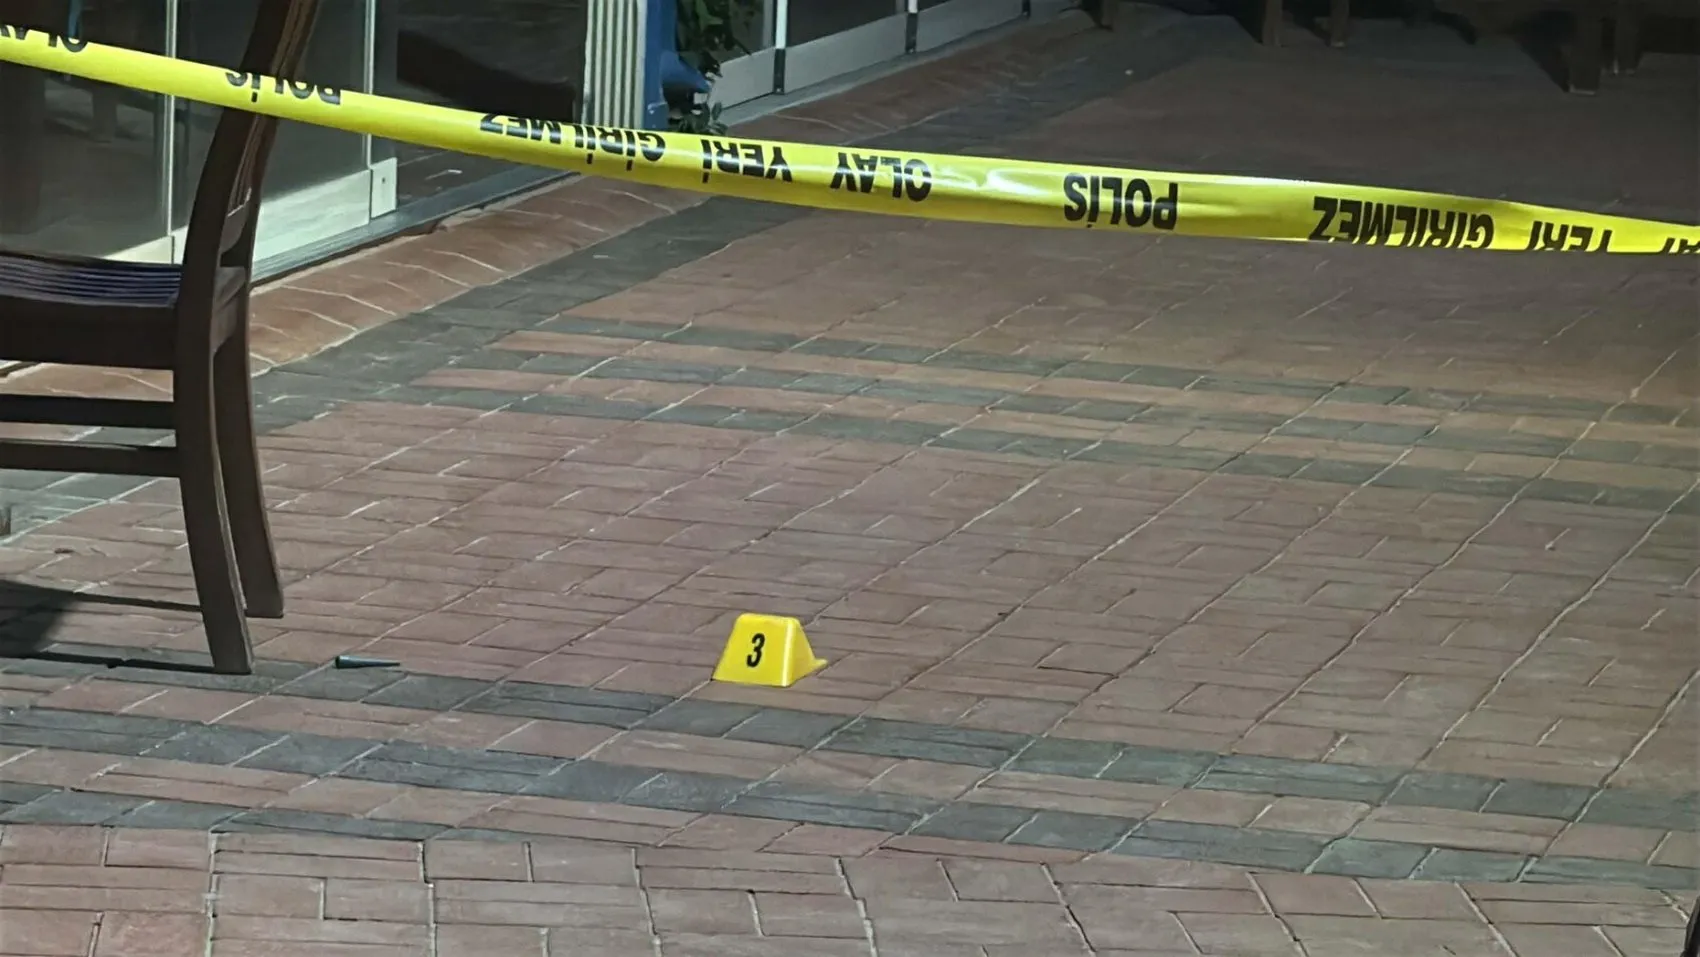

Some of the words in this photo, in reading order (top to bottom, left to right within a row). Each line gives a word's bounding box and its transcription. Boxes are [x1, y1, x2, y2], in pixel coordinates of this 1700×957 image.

[701, 139, 792, 183] YERİ
[830, 152, 932, 202] OLAY
[1063, 172, 1178, 230] POLİS
[746, 632, 765, 668] 3
